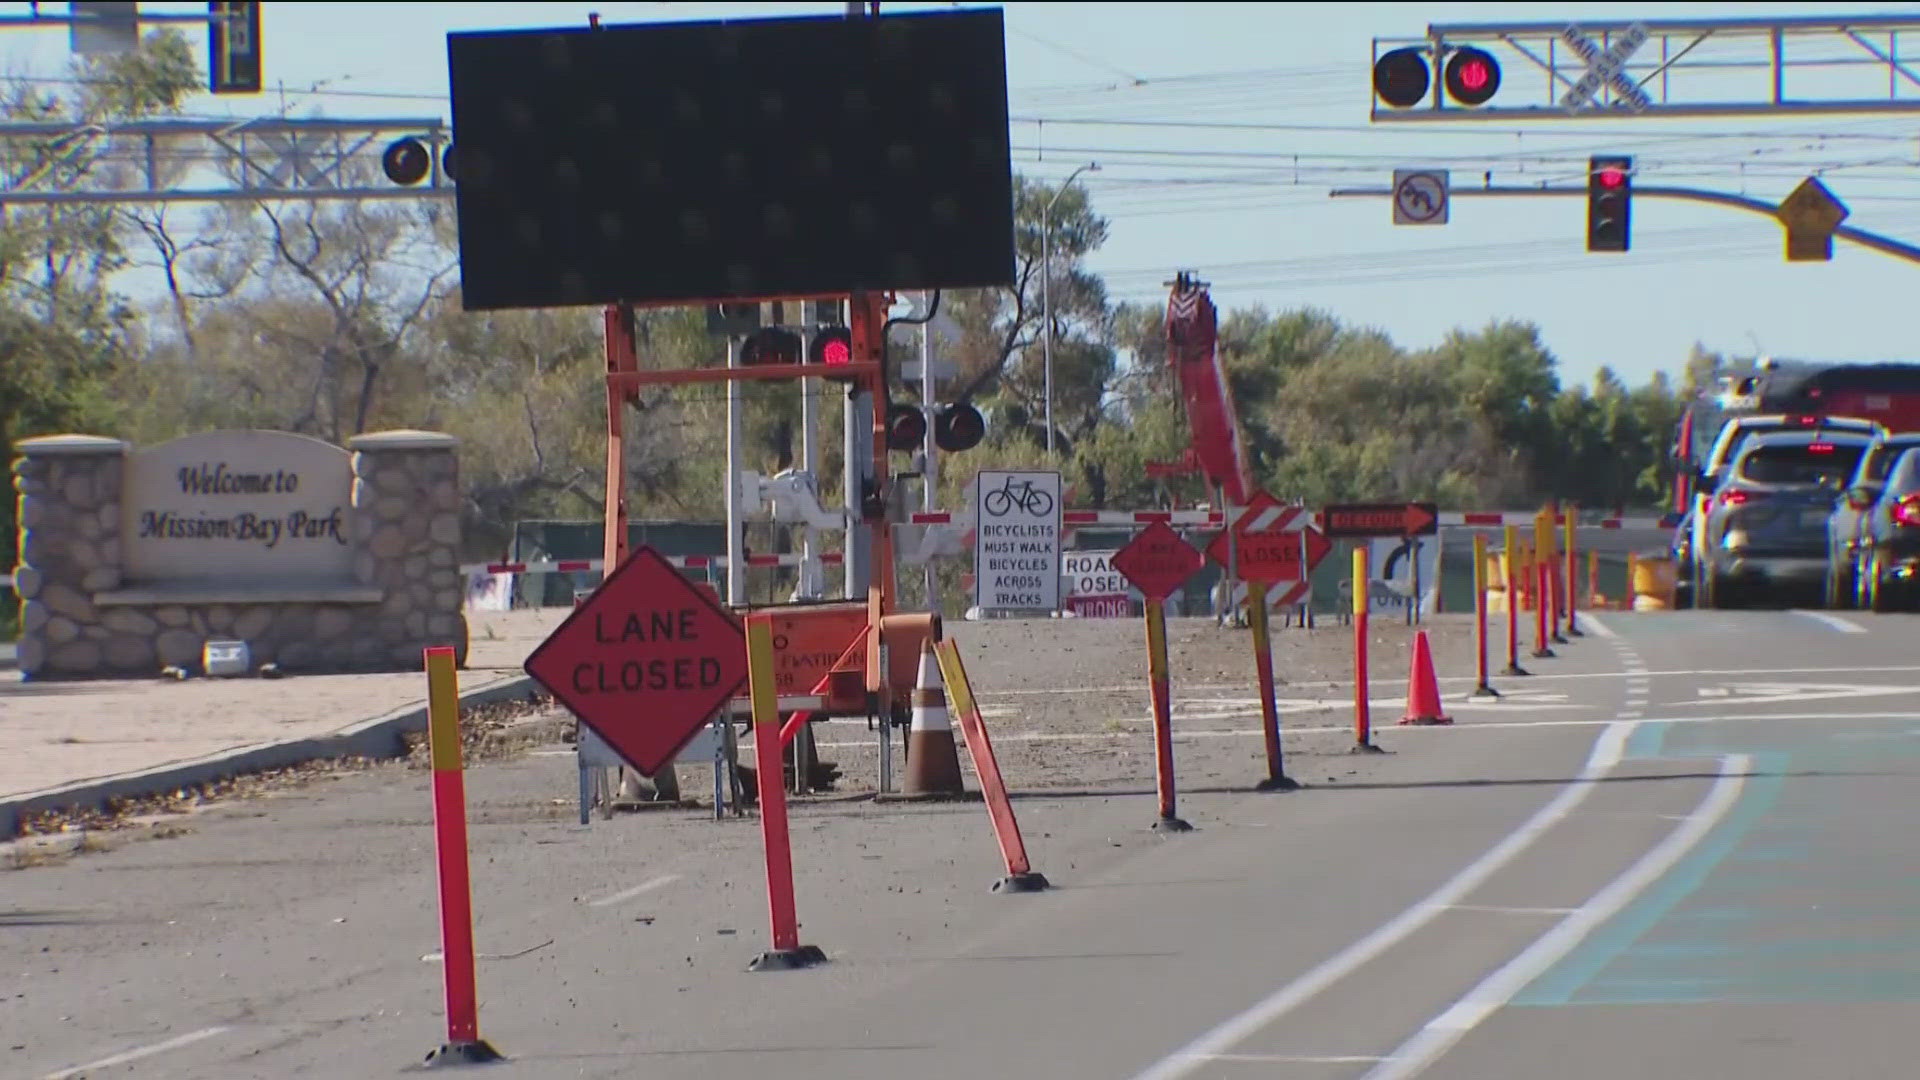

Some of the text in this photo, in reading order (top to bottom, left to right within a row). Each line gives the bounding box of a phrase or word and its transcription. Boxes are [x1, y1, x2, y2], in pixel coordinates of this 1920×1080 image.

[1563, 27, 1647, 110] RAIL ROAD
[1565, 27, 1645, 107] CROSSING
[178, 462, 299, 495] Welcome to
[140, 507, 348, 550] Mission Bay Park
[983, 525, 1054, 538] BICYCLISTS
[984, 541, 1053, 554] MUST WALK
[989, 558, 1048, 571] BICYCLES
[994, 575, 1042, 588] ACROSS
[995, 593, 1042, 605] TRACKS
[1073, 599, 1127, 618] WRONG
[595, 609, 699, 644] LANE
[571, 656, 723, 695] CLOSED
